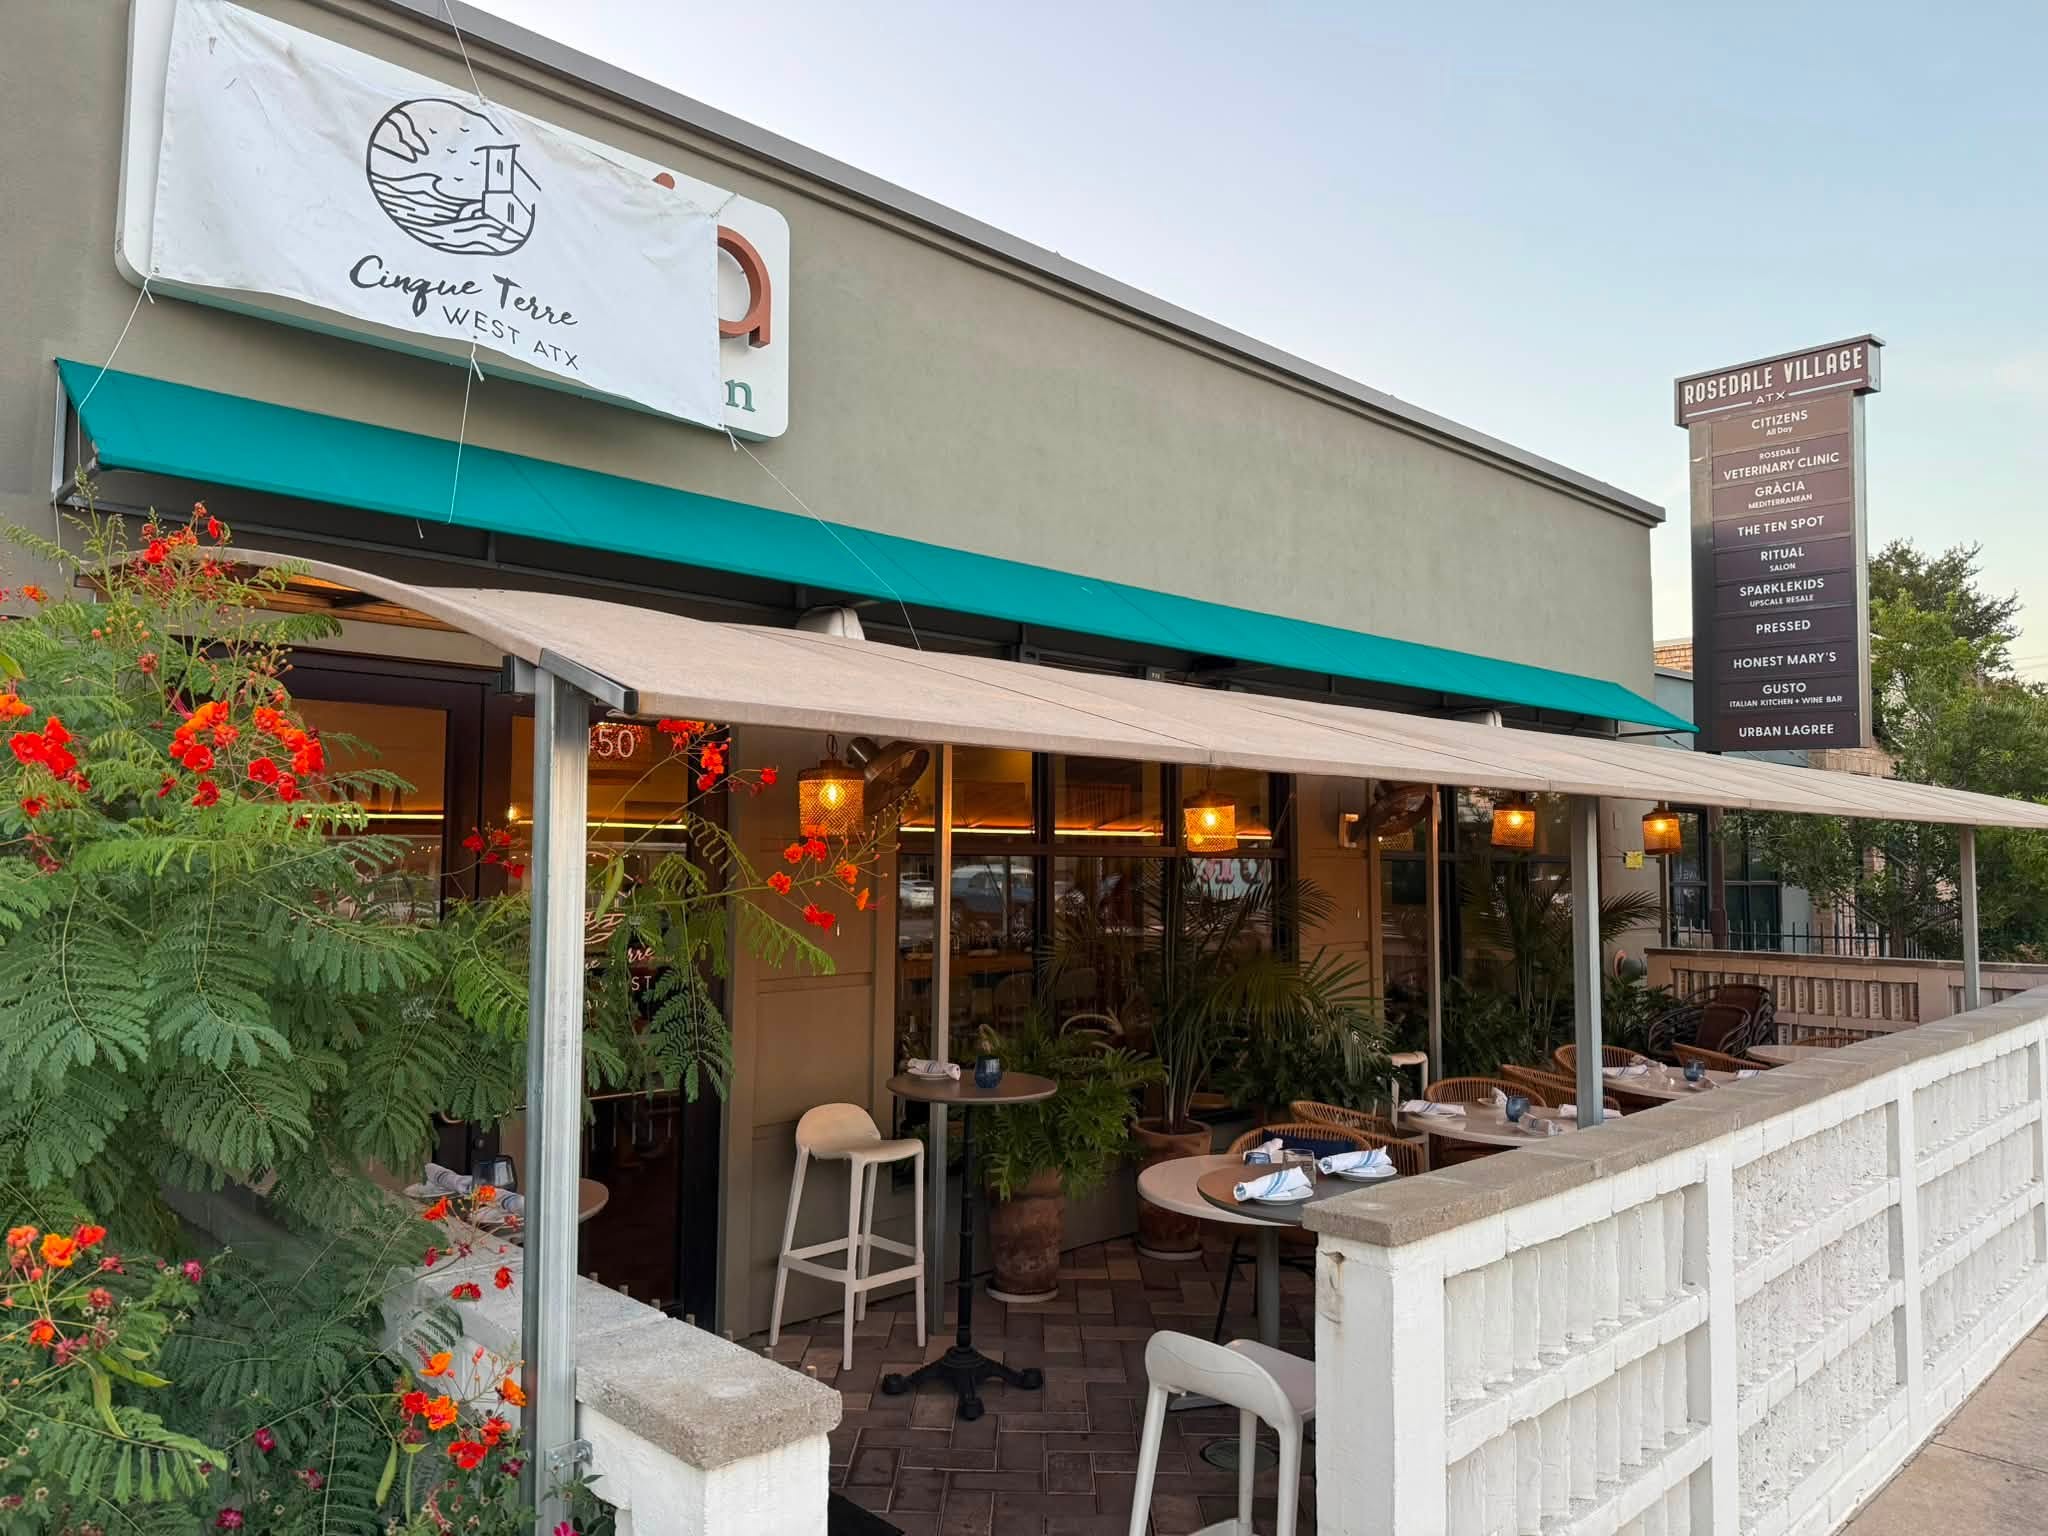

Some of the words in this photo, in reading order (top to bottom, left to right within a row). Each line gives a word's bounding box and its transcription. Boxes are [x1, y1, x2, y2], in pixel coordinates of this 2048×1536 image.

[349, 254, 482, 317] Cinque
[492, 273, 578, 326] Terre
[442, 305, 520, 345] WEST
[533, 340, 579, 370] ATX
[1684, 367, 1773, 405] ROSEDALE
[1784, 347, 1863, 384] VILLAGE
[1755, 391, 1785, 405] ATX
[1751, 409, 1808, 430] CITIZENS
[1759, 446, 1801, 460] ROSEDALE
[1723, 459, 1795, 481] VETERINARY
[1797, 452, 1840, 468] CLINIC
[1754, 480, 1806, 497] GRÀCIA
[1748, 493, 1813, 509] MEDITERRANEAN
[1737, 524, 1760, 537] THE
[1763, 520, 1787, 534] TEN
[1790, 515, 1825, 530] SPOT
[1760, 547, 1805, 561] RITUAL
[1769, 562, 1796, 572] SALON
[1739, 578, 1825, 597] SPARKLEKIDS
[1749, 597, 1783, 608] UPSCALE
[1785, 594, 1814, 604] RESALE
[1756, 619, 1811, 634] PRESSED
[1733, 655, 1784, 669] HONEST
[1787, 651, 1837, 665] MARY'S
[1762, 682, 1807, 695] GUSTO
[1729, 700, 1758, 709] ITALIAN
[1760, 698, 1794, 706] KITCHEN
[1801, 696, 1823, 704] WINE
[1825, 695, 1843, 703] BAR
[1738, 725, 1782, 738] URBAN
[1784, 723, 1835, 736] LAGREE
